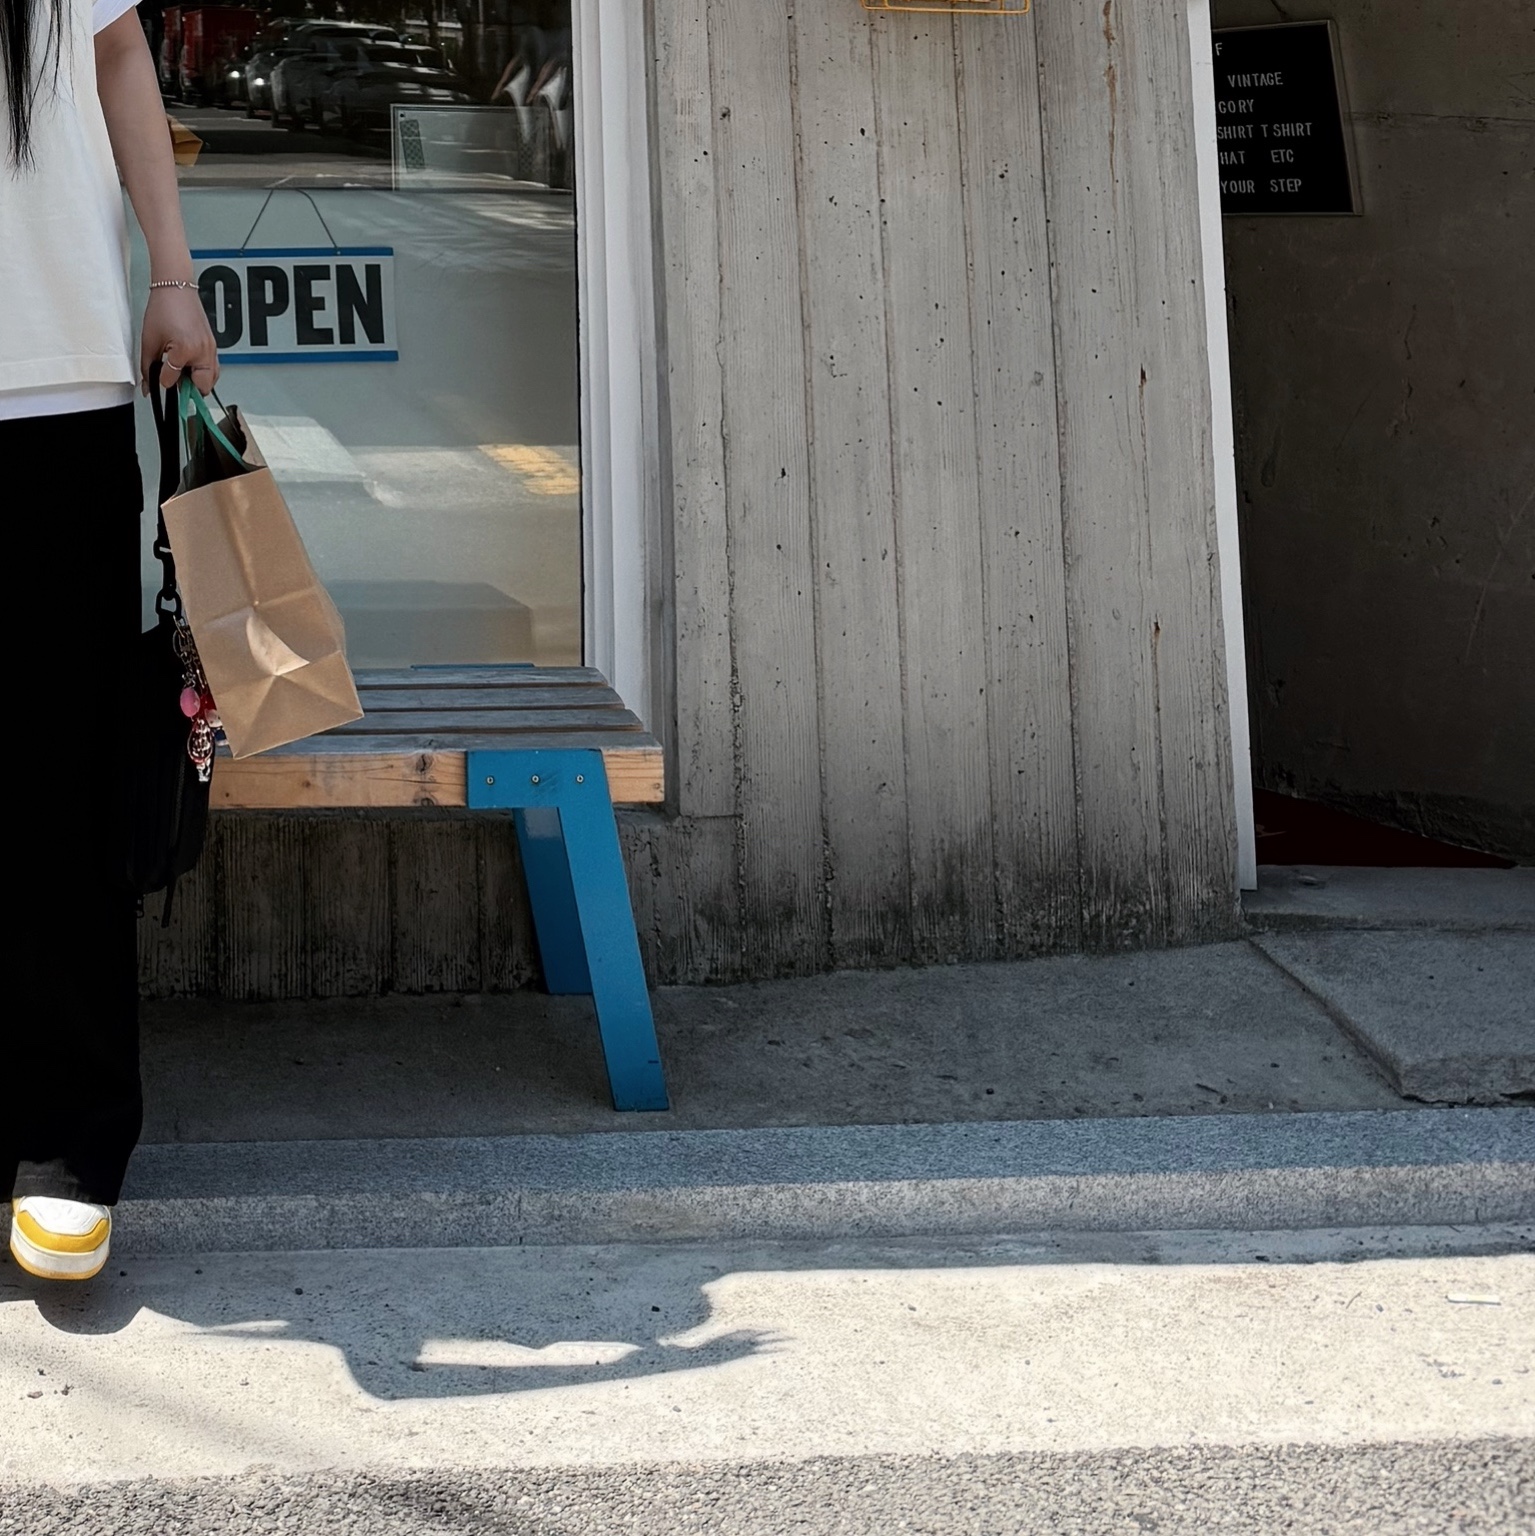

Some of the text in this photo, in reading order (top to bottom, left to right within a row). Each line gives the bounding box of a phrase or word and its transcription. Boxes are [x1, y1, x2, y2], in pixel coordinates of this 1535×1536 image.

[1227, 71, 1284, 88] VINTAGE
[1217, 124, 1254, 140] SHIRT
[1273, 122, 1313, 137] SHIRT
[1220, 149, 1295, 165] HAT ETC
[1221, 178, 1302, 195] YOUR STEP
[197, 263, 386, 349] OPEN
